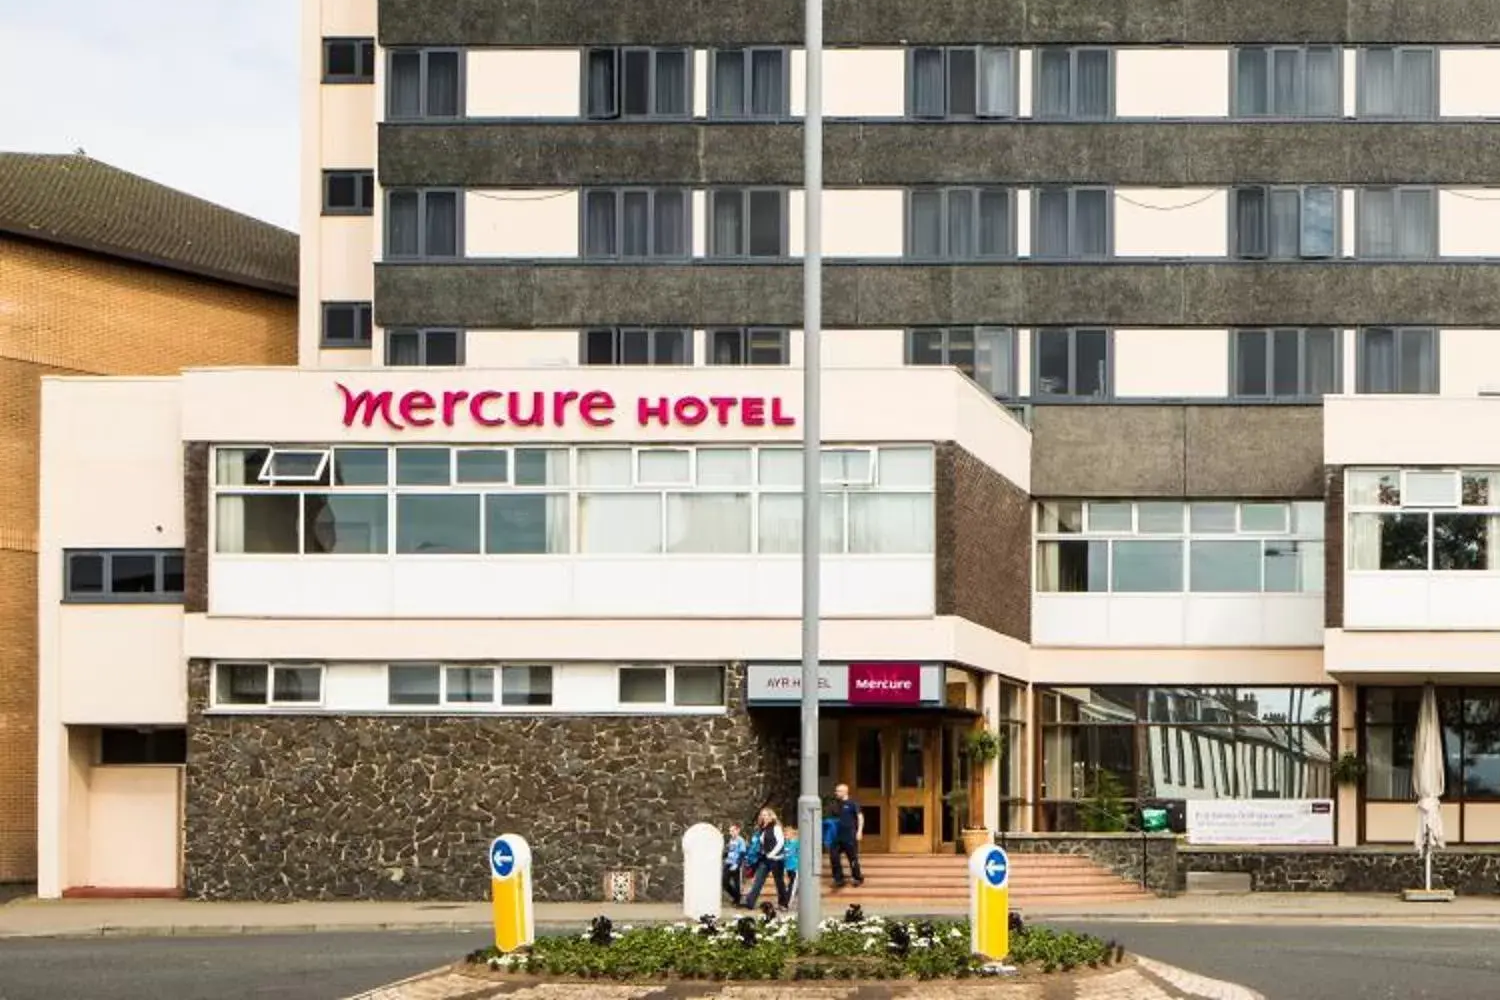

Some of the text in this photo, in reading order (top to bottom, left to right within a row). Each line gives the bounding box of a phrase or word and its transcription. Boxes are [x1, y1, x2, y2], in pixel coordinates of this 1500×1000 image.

[637, 395, 796, 427] HOTEL
[767, 677, 831, 689] AYR HEL
